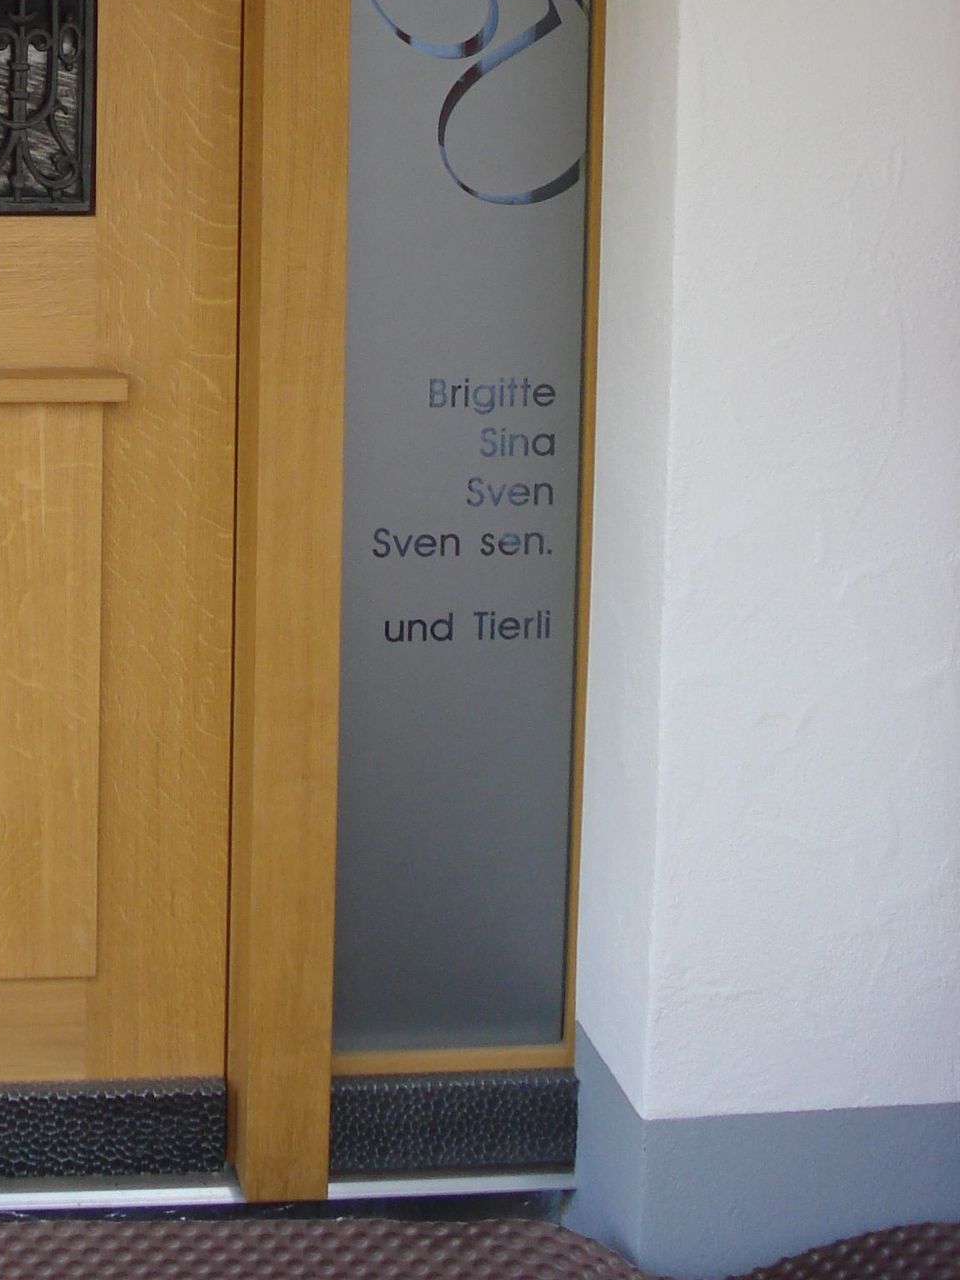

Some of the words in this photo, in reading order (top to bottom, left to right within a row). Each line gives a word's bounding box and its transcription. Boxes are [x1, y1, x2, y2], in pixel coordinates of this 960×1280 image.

[429, 377, 556, 415] Brigitte
[479, 426, 556, 458] Sina
[466, 476, 554, 507] Sven
[372, 527, 460, 558] Sven
[480, 531, 553, 556] sen.
[384, 611, 454, 643] und
[473, 610, 551, 641] Tierli
